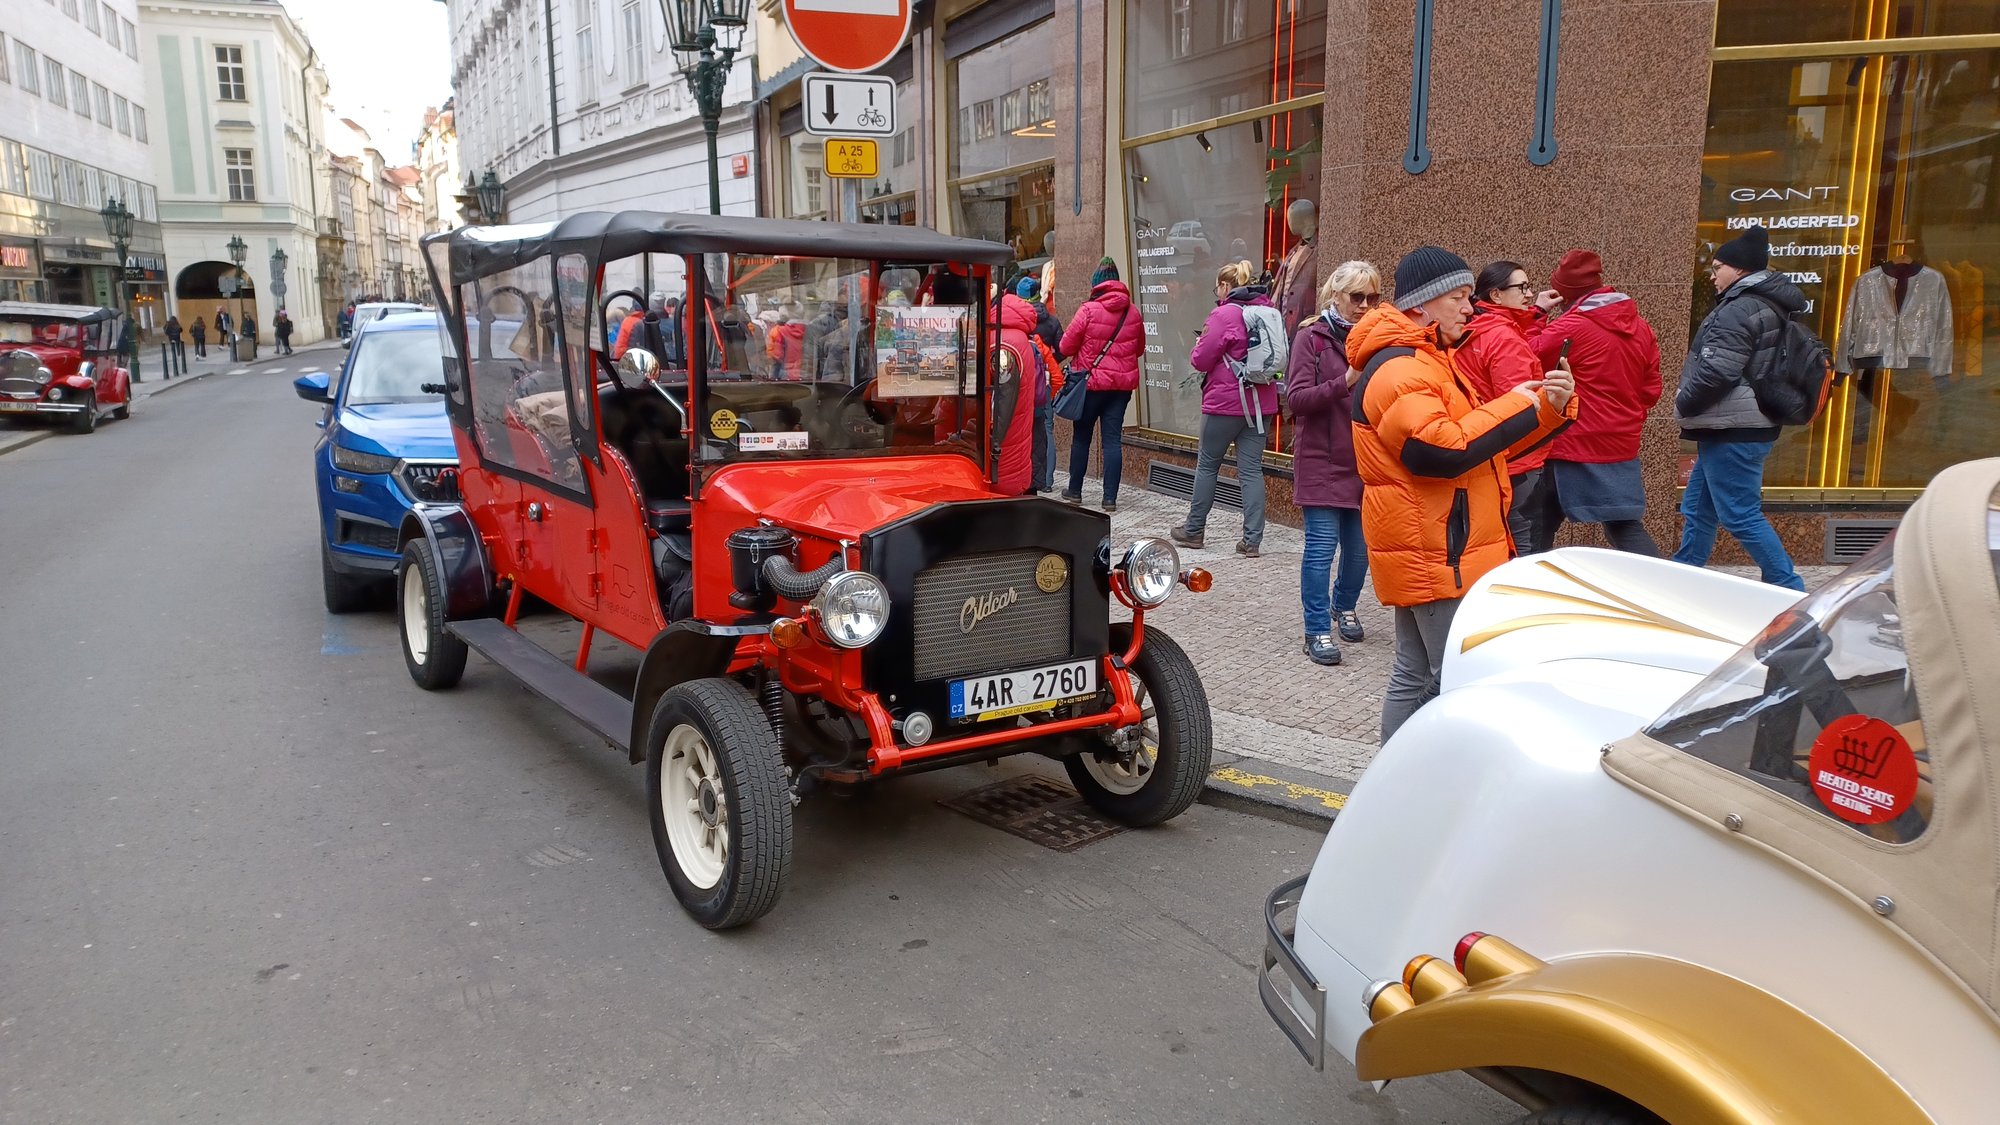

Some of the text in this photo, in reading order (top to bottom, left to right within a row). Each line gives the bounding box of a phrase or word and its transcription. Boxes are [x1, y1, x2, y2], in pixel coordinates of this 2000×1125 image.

[838, 145, 863, 156] A 25
[1730, 186, 1840, 202] GANT
[1769, 215, 1860, 229] LAGERFELD
[1136, 227, 1166, 239] GANT
[1149, 246, 1175, 257] LAGERFELD
[1146, 378, 1155, 388] odd
[960, 586, 1018, 634] Oldcar
[970, 665, 1087, 710] 4AR 2760
[951, 703, 964, 714] CZ
[1818, 770, 1895, 807] HEATED SEATS
[1831, 793, 1873, 816] HEATING
